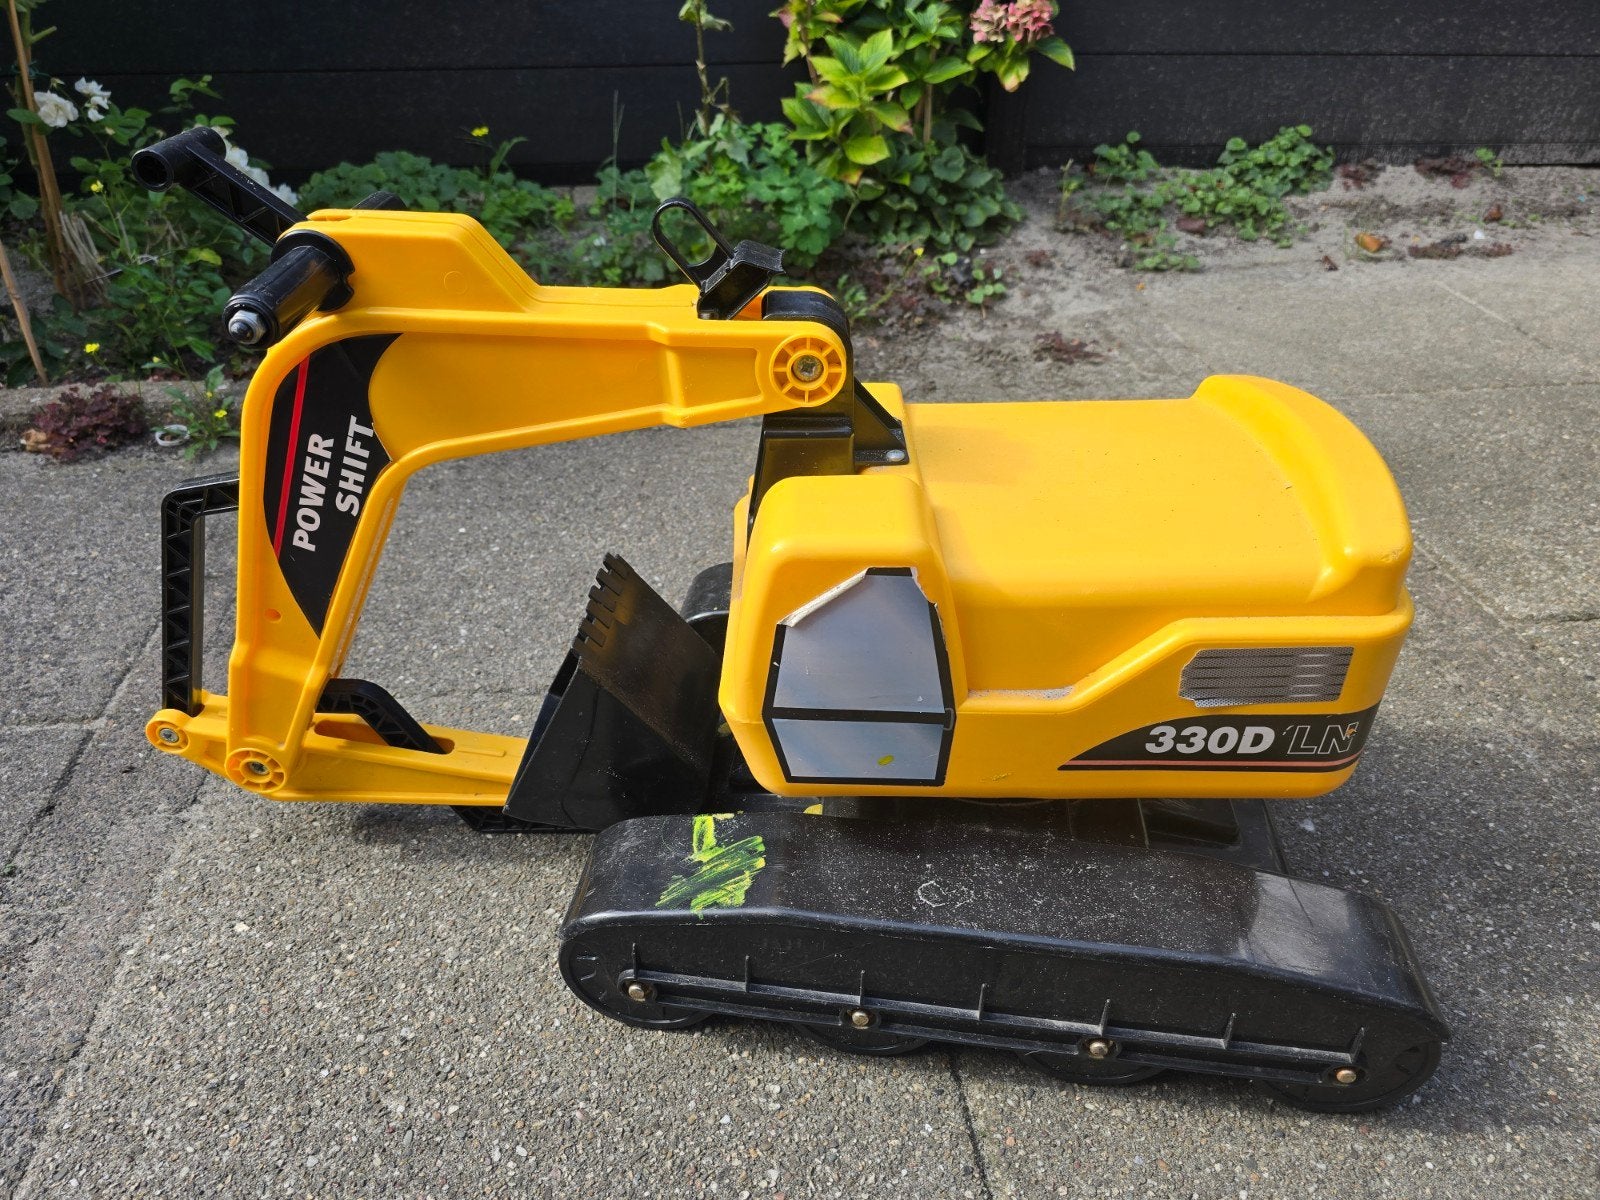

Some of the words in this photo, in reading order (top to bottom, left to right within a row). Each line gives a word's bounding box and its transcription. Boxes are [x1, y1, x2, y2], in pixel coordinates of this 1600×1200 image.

[293, 433, 335, 552] POWER
[335, 414, 374, 517] SHIFT
[1145, 725, 1276, 754] 330D
